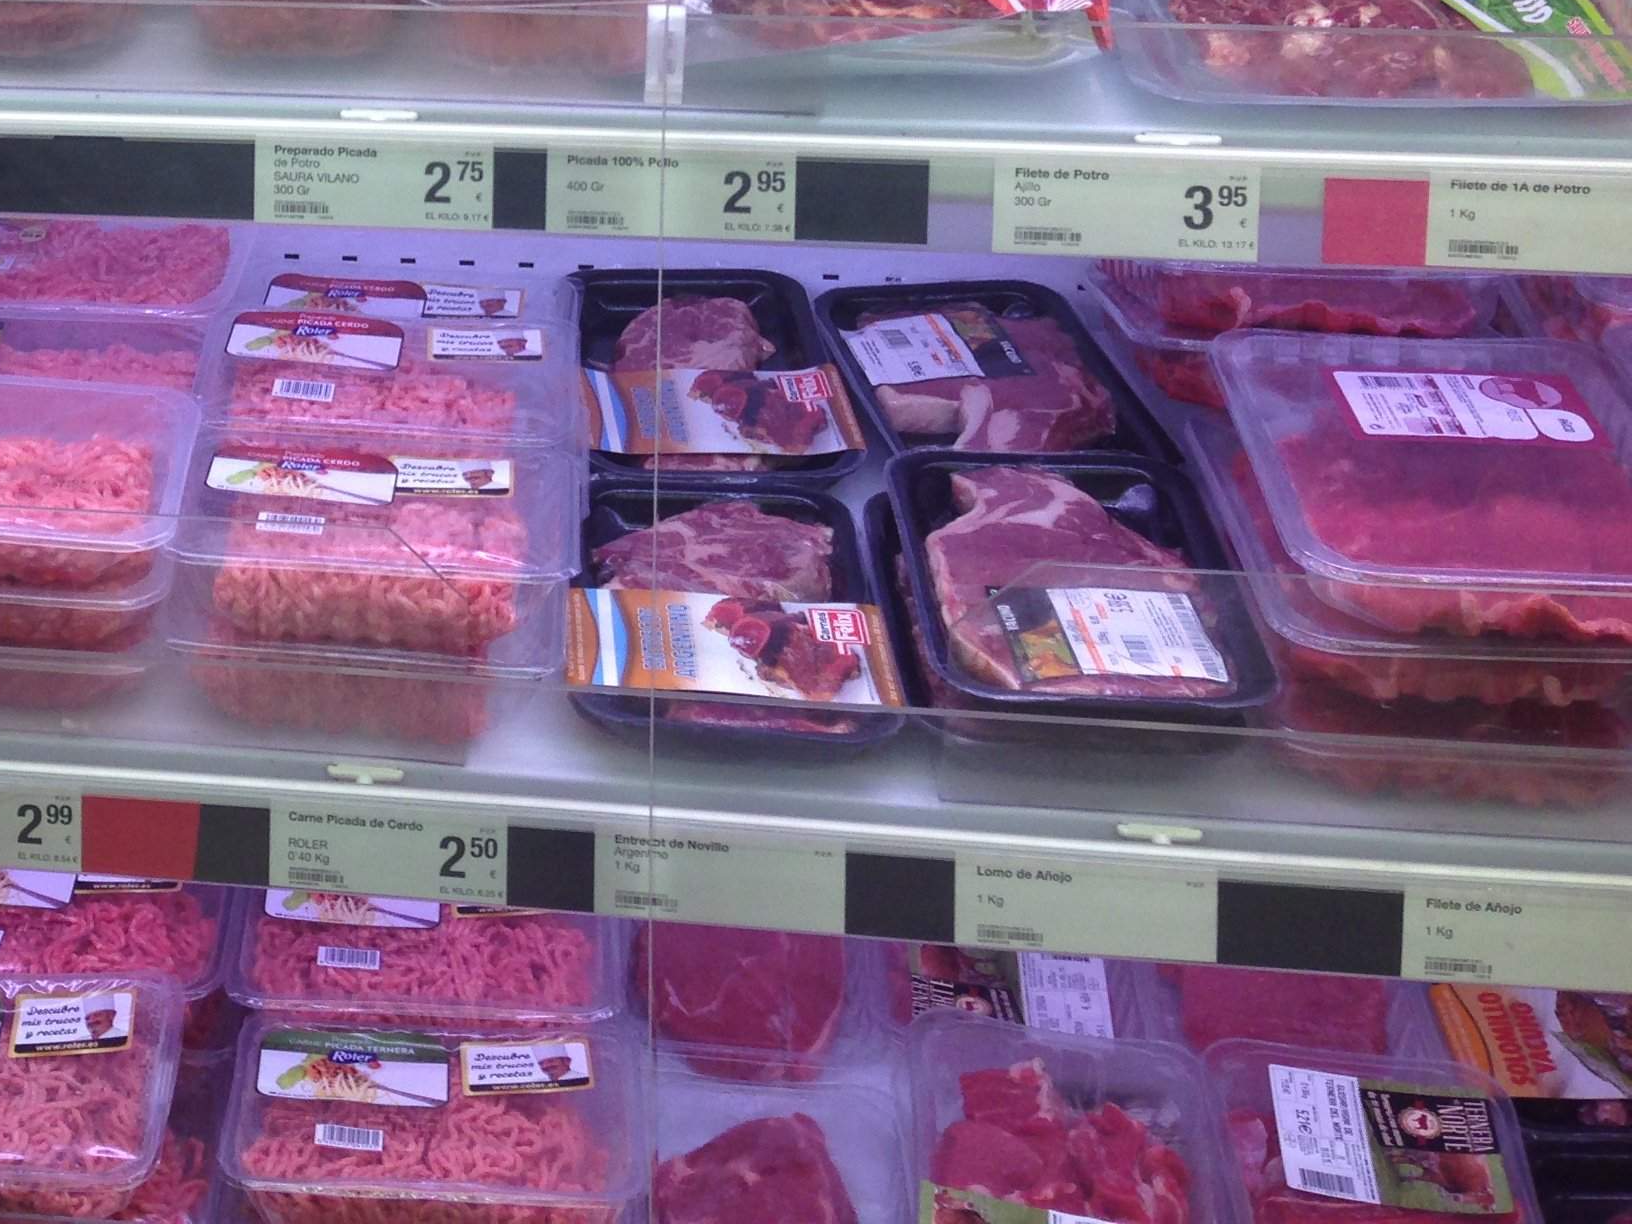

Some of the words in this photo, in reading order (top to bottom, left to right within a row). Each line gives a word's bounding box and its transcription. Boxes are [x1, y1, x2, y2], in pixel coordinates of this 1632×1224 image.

[274, 144, 335, 158] Preparado
[338, 146, 378, 158] Picada
[291, 158, 321, 169] Potro
[567, 154, 608, 167] Picada
[611, 155, 645, 168] 100%
[273, 171, 314, 183] SAURA
[424, 160, 452, 204] 2
[456, 159, 484, 183] 75
[1015, 167, 1050, 180] Filete
[1053, 168, 1070, 180] de
[1074, 169, 1110, 181] Potro
[722, 170, 752, 214] 2
[757, 169, 787, 193] 95
[1450, 179, 1487, 191] Filete
[1553, 184, 1592, 195] Potro
[1183, 184, 1214, 230] 3
[1217, 184, 1248, 207] 95
[17, 803, 43, 845] 2
[46, 804, 73, 825] 99
[288, 810, 324, 824] Carne
[327, 813, 367, 827] Picada
[369, 817, 385, 828] de
[387, 819, 424, 832] Cerdo
[288, 837, 329, 849] ROLER
[614, 834, 667, 848] Entrecot
[668, 838, 685, 849] de
[687, 840, 730, 853] Novillo
[439, 835, 467, 879] 2
[470, 836, 499, 859] 50
[976, 866, 1013, 879] Lomo
[1016, 868, 1032, 880] de
[1426, 897, 1462, 911] Filete
[1465, 900, 1482, 912] de
[331, 1051, 375, 1064] Roler
